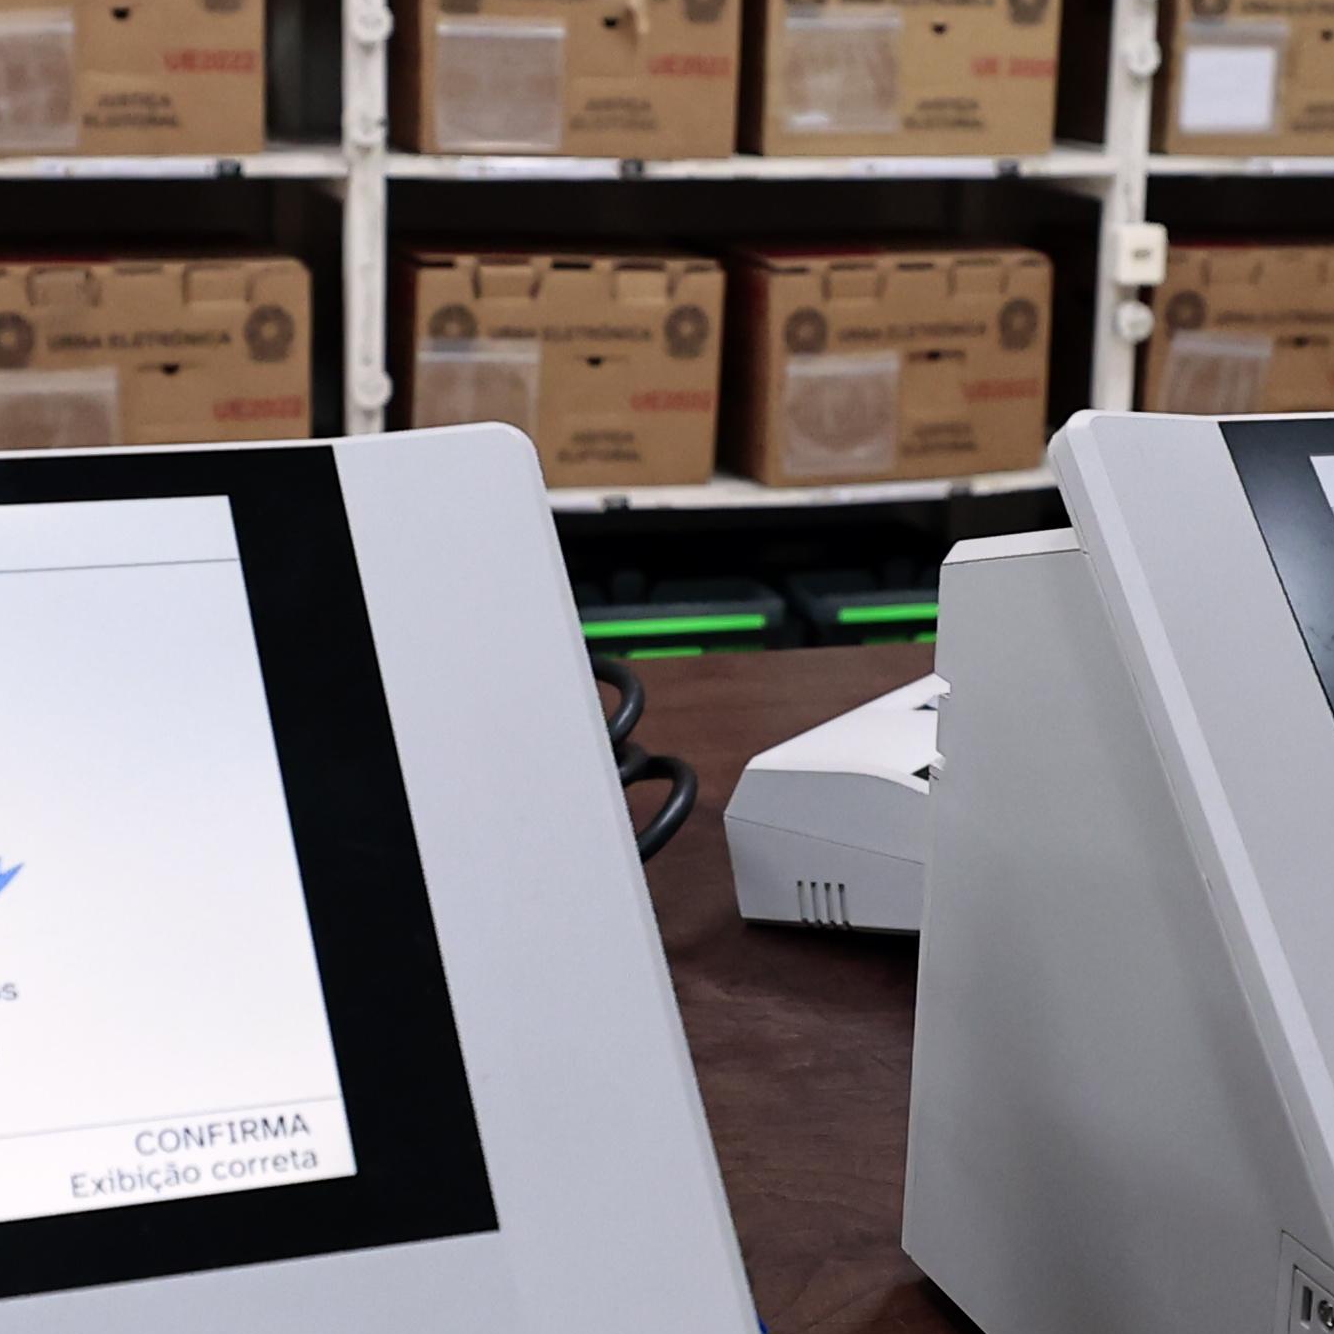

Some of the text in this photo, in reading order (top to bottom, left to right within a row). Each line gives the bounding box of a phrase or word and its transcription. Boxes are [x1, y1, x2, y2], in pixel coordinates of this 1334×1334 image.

[134, 1112, 311, 1159] CONFIRMA
[70, 1143, 319, 1201] Exibição correta
